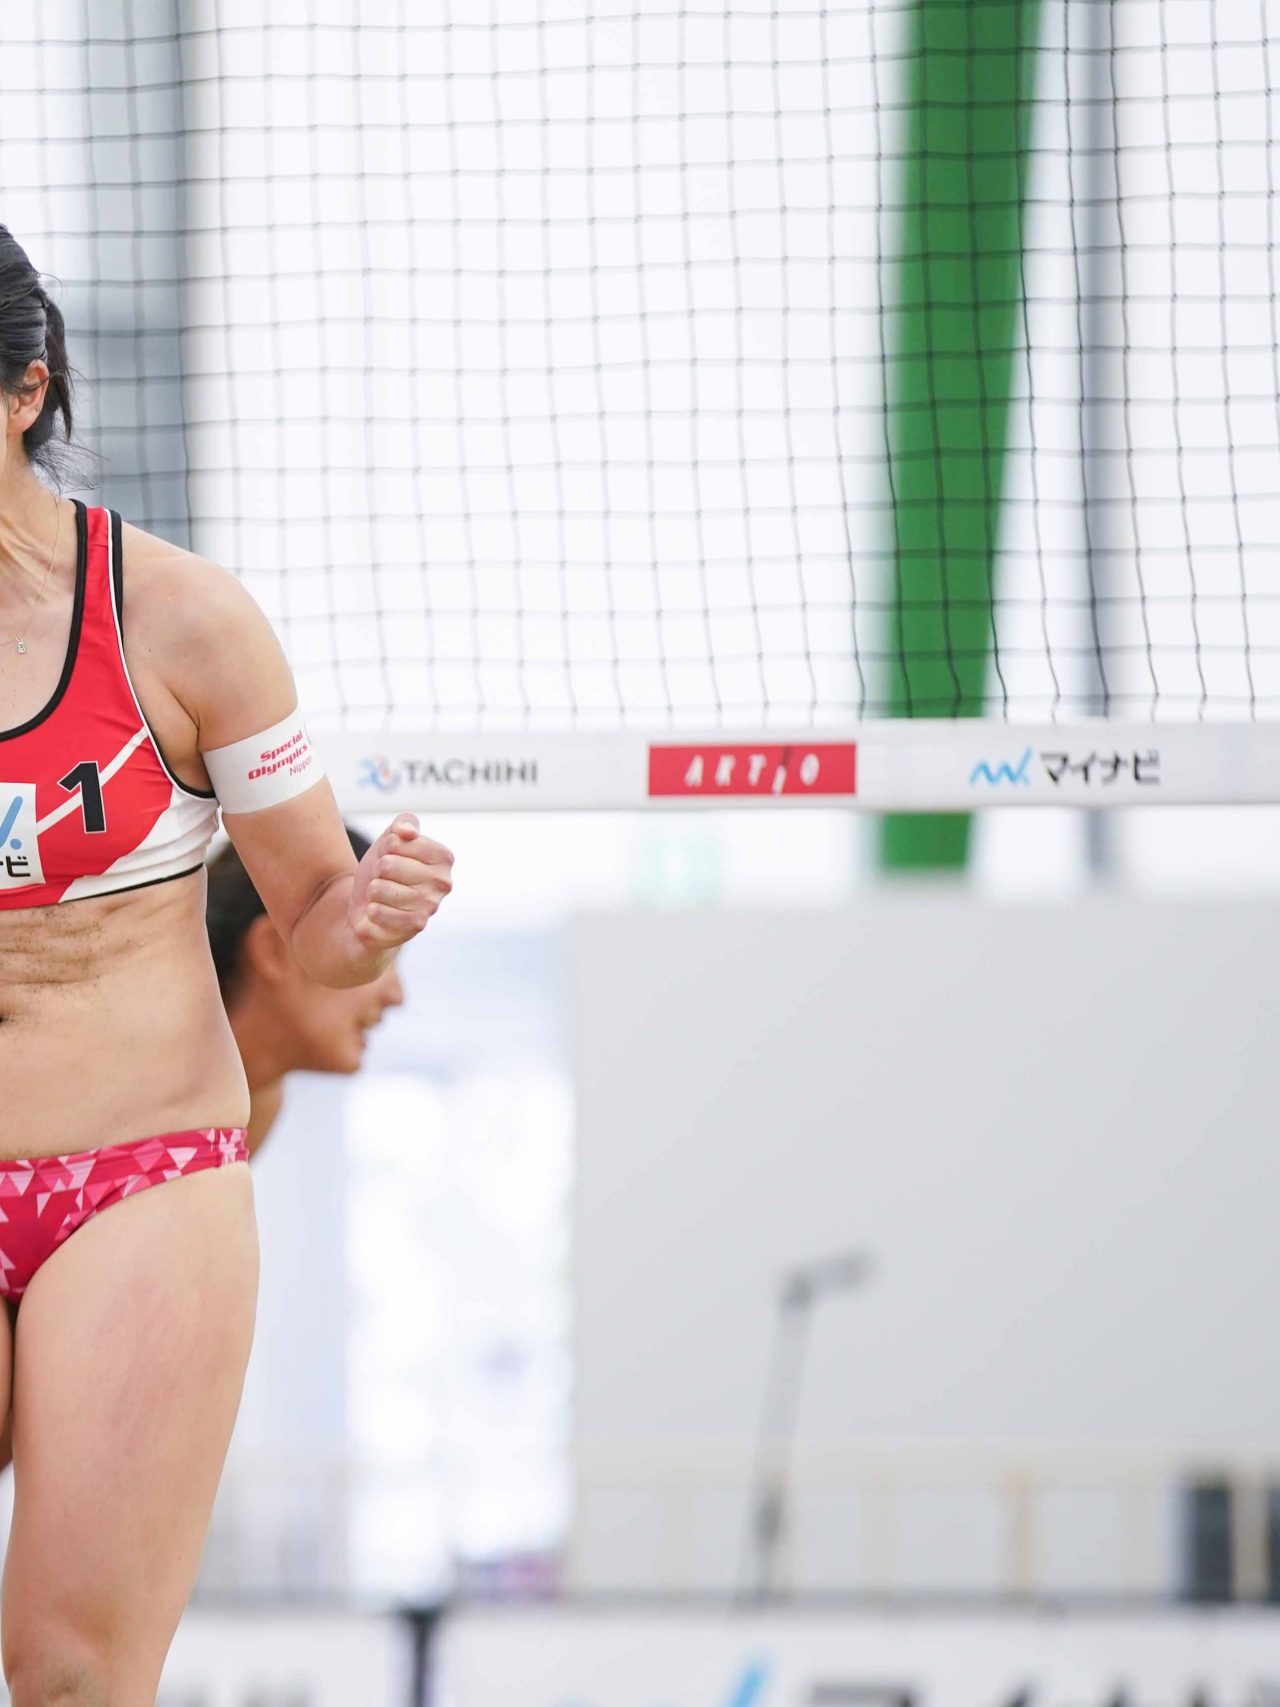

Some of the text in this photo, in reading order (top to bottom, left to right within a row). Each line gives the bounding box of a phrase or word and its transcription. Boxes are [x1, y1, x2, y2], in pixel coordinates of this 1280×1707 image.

[248, 743, 308, 780] Olympics
[260, 729, 303, 762] Special
[1040, 749, 1160, 787] マイナビ
[58, 761, 107, 834] 1
